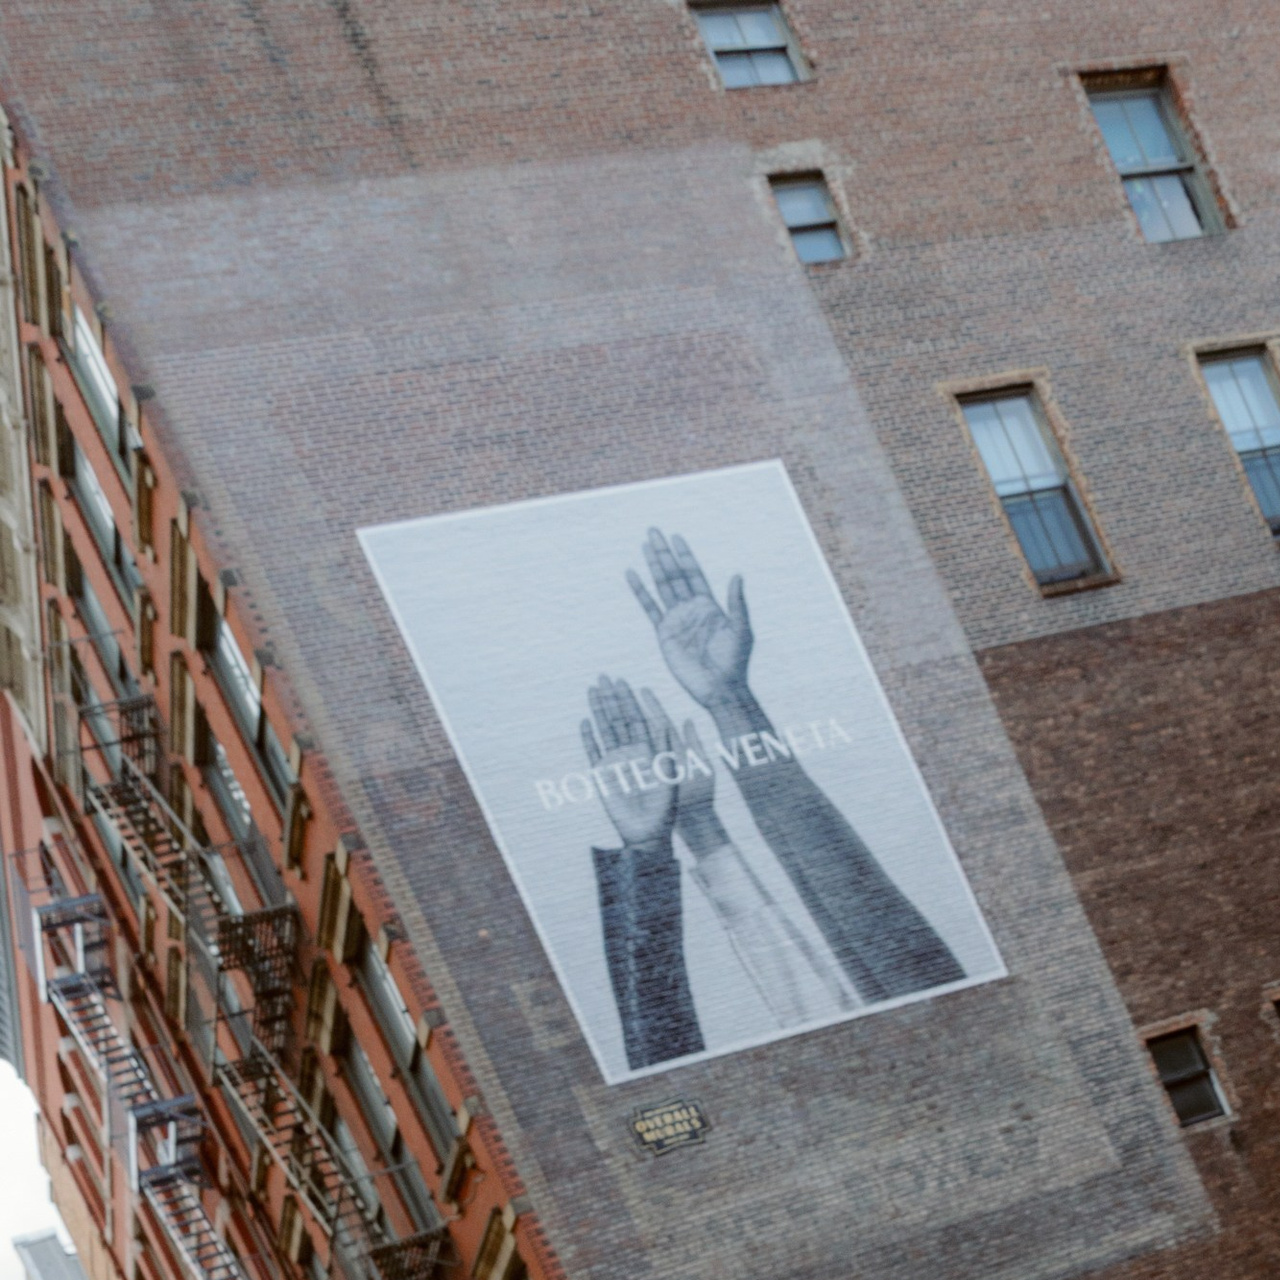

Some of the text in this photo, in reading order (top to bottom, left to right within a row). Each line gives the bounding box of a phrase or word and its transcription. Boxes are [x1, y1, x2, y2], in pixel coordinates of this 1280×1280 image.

[534, 718, 853, 812] BOTTEGA VENETA
[634, 1105, 699, 1133] OVERALL
[642, 1117, 702, 1143] MURALS
